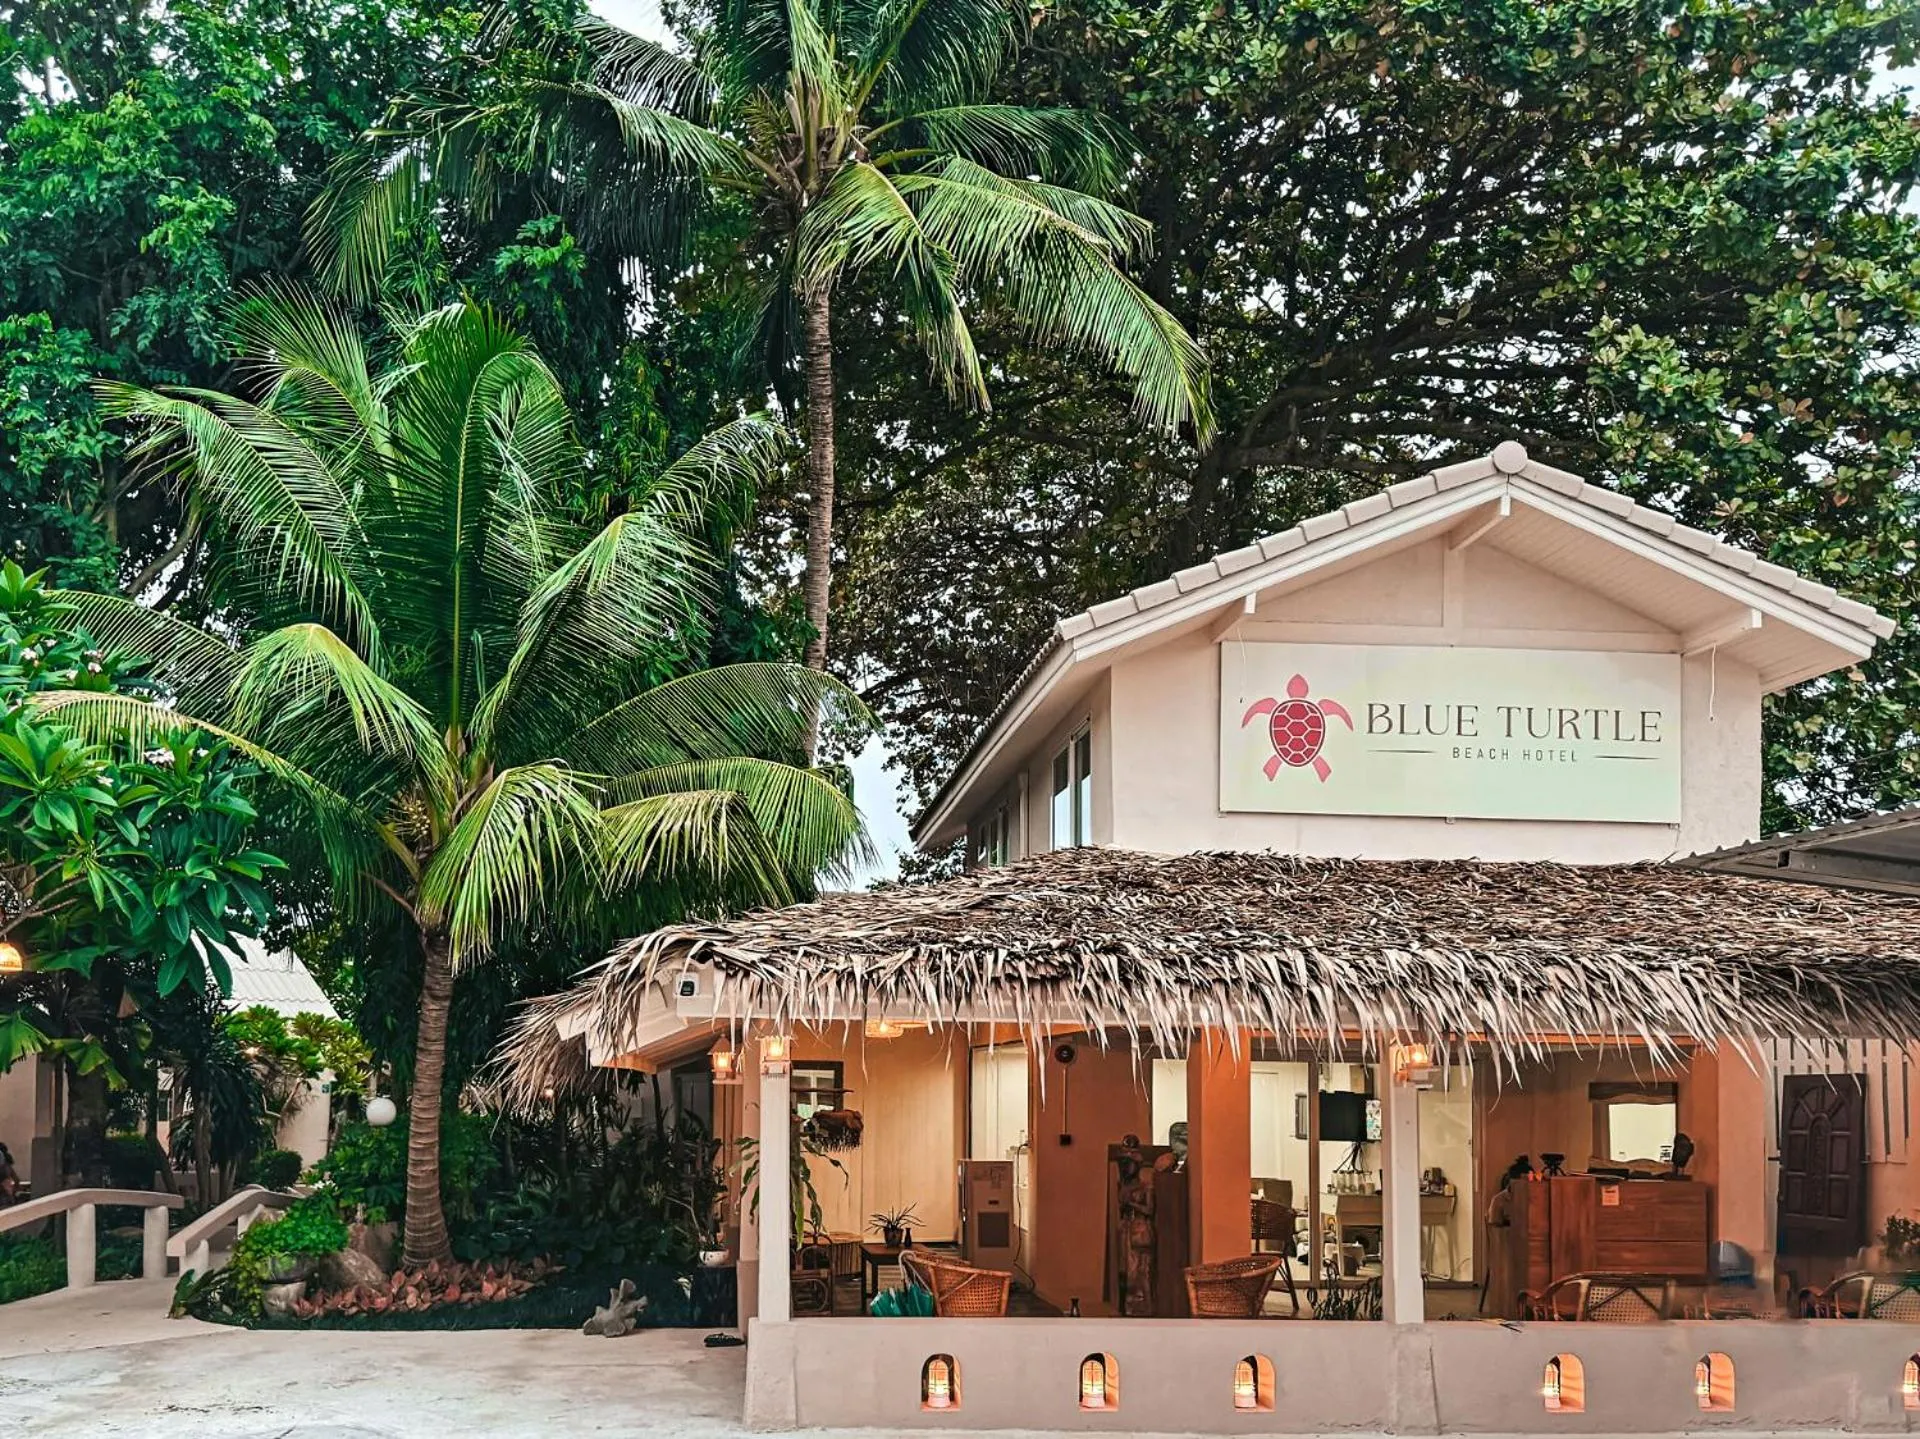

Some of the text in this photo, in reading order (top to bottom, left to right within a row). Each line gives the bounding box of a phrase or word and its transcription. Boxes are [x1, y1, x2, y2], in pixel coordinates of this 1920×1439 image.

[1366, 703, 1662, 742] BLUE TURTLE
[1452, 746, 1577, 763] BEACH HOTEL
